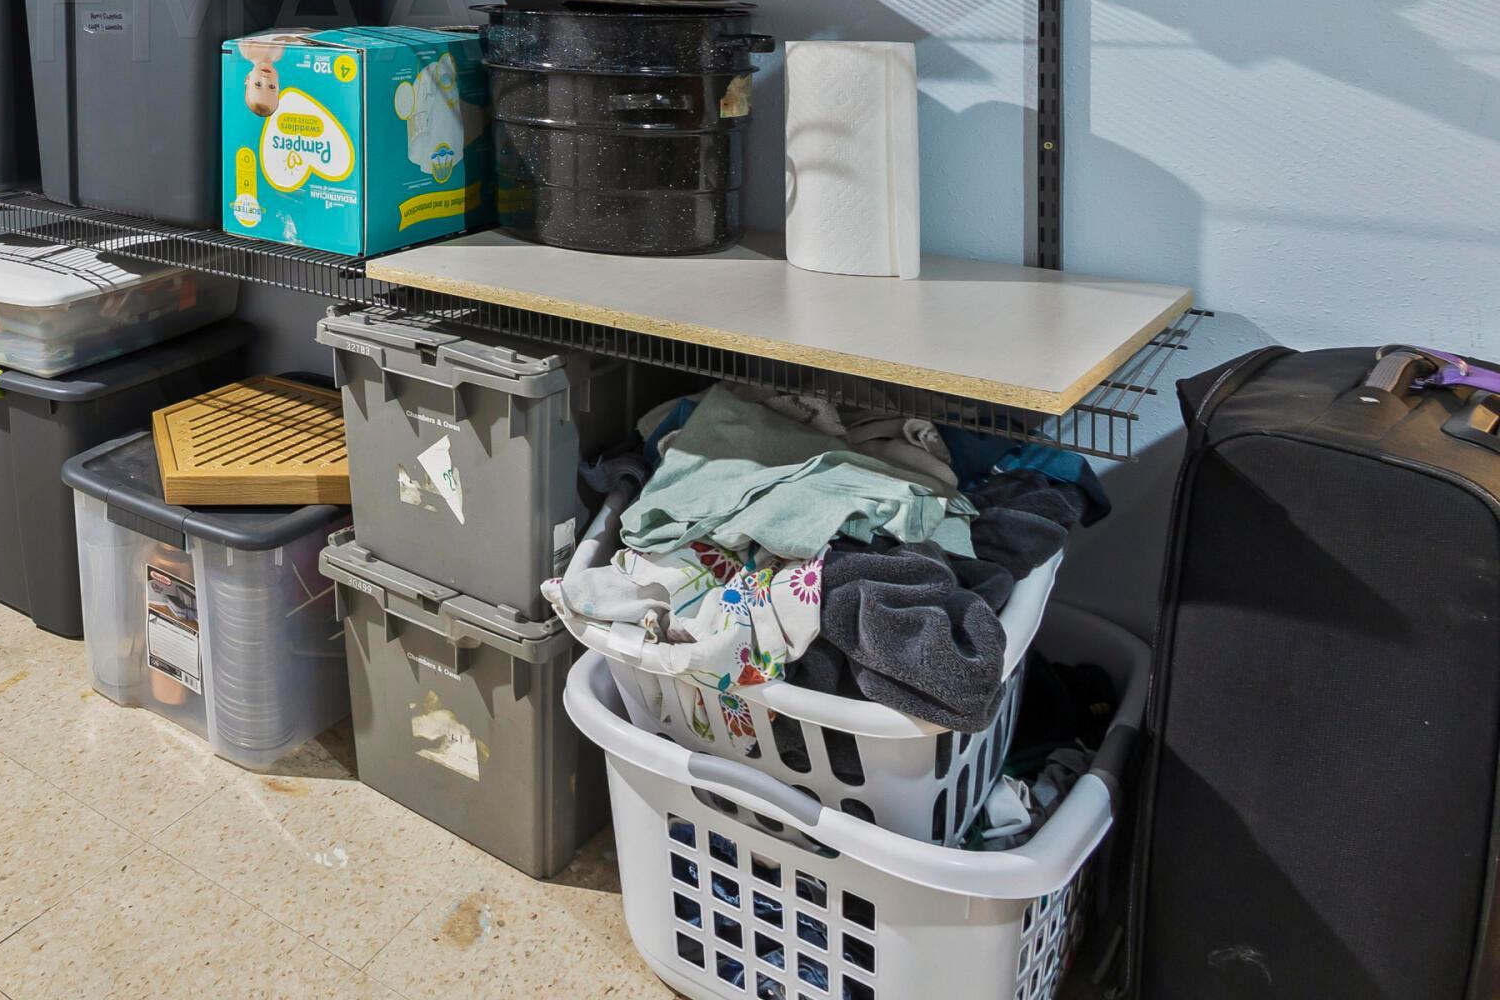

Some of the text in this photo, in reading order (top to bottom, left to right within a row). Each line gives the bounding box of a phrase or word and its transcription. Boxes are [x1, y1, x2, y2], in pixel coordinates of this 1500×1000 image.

[313, 61, 332, 74] 120
[340, 65, 350, 78] 4
[280, 122, 321, 134] swaddlers
[272, 134, 332, 164] Pampers
[310, 190, 357, 205] PEDIATRICIAN
[405, 409, 461, 432] Chambers & Owen
[347, 576, 372, 594] 30499
[406, 652, 437, 670] Chambers
[437, 665, 443, 673] &
